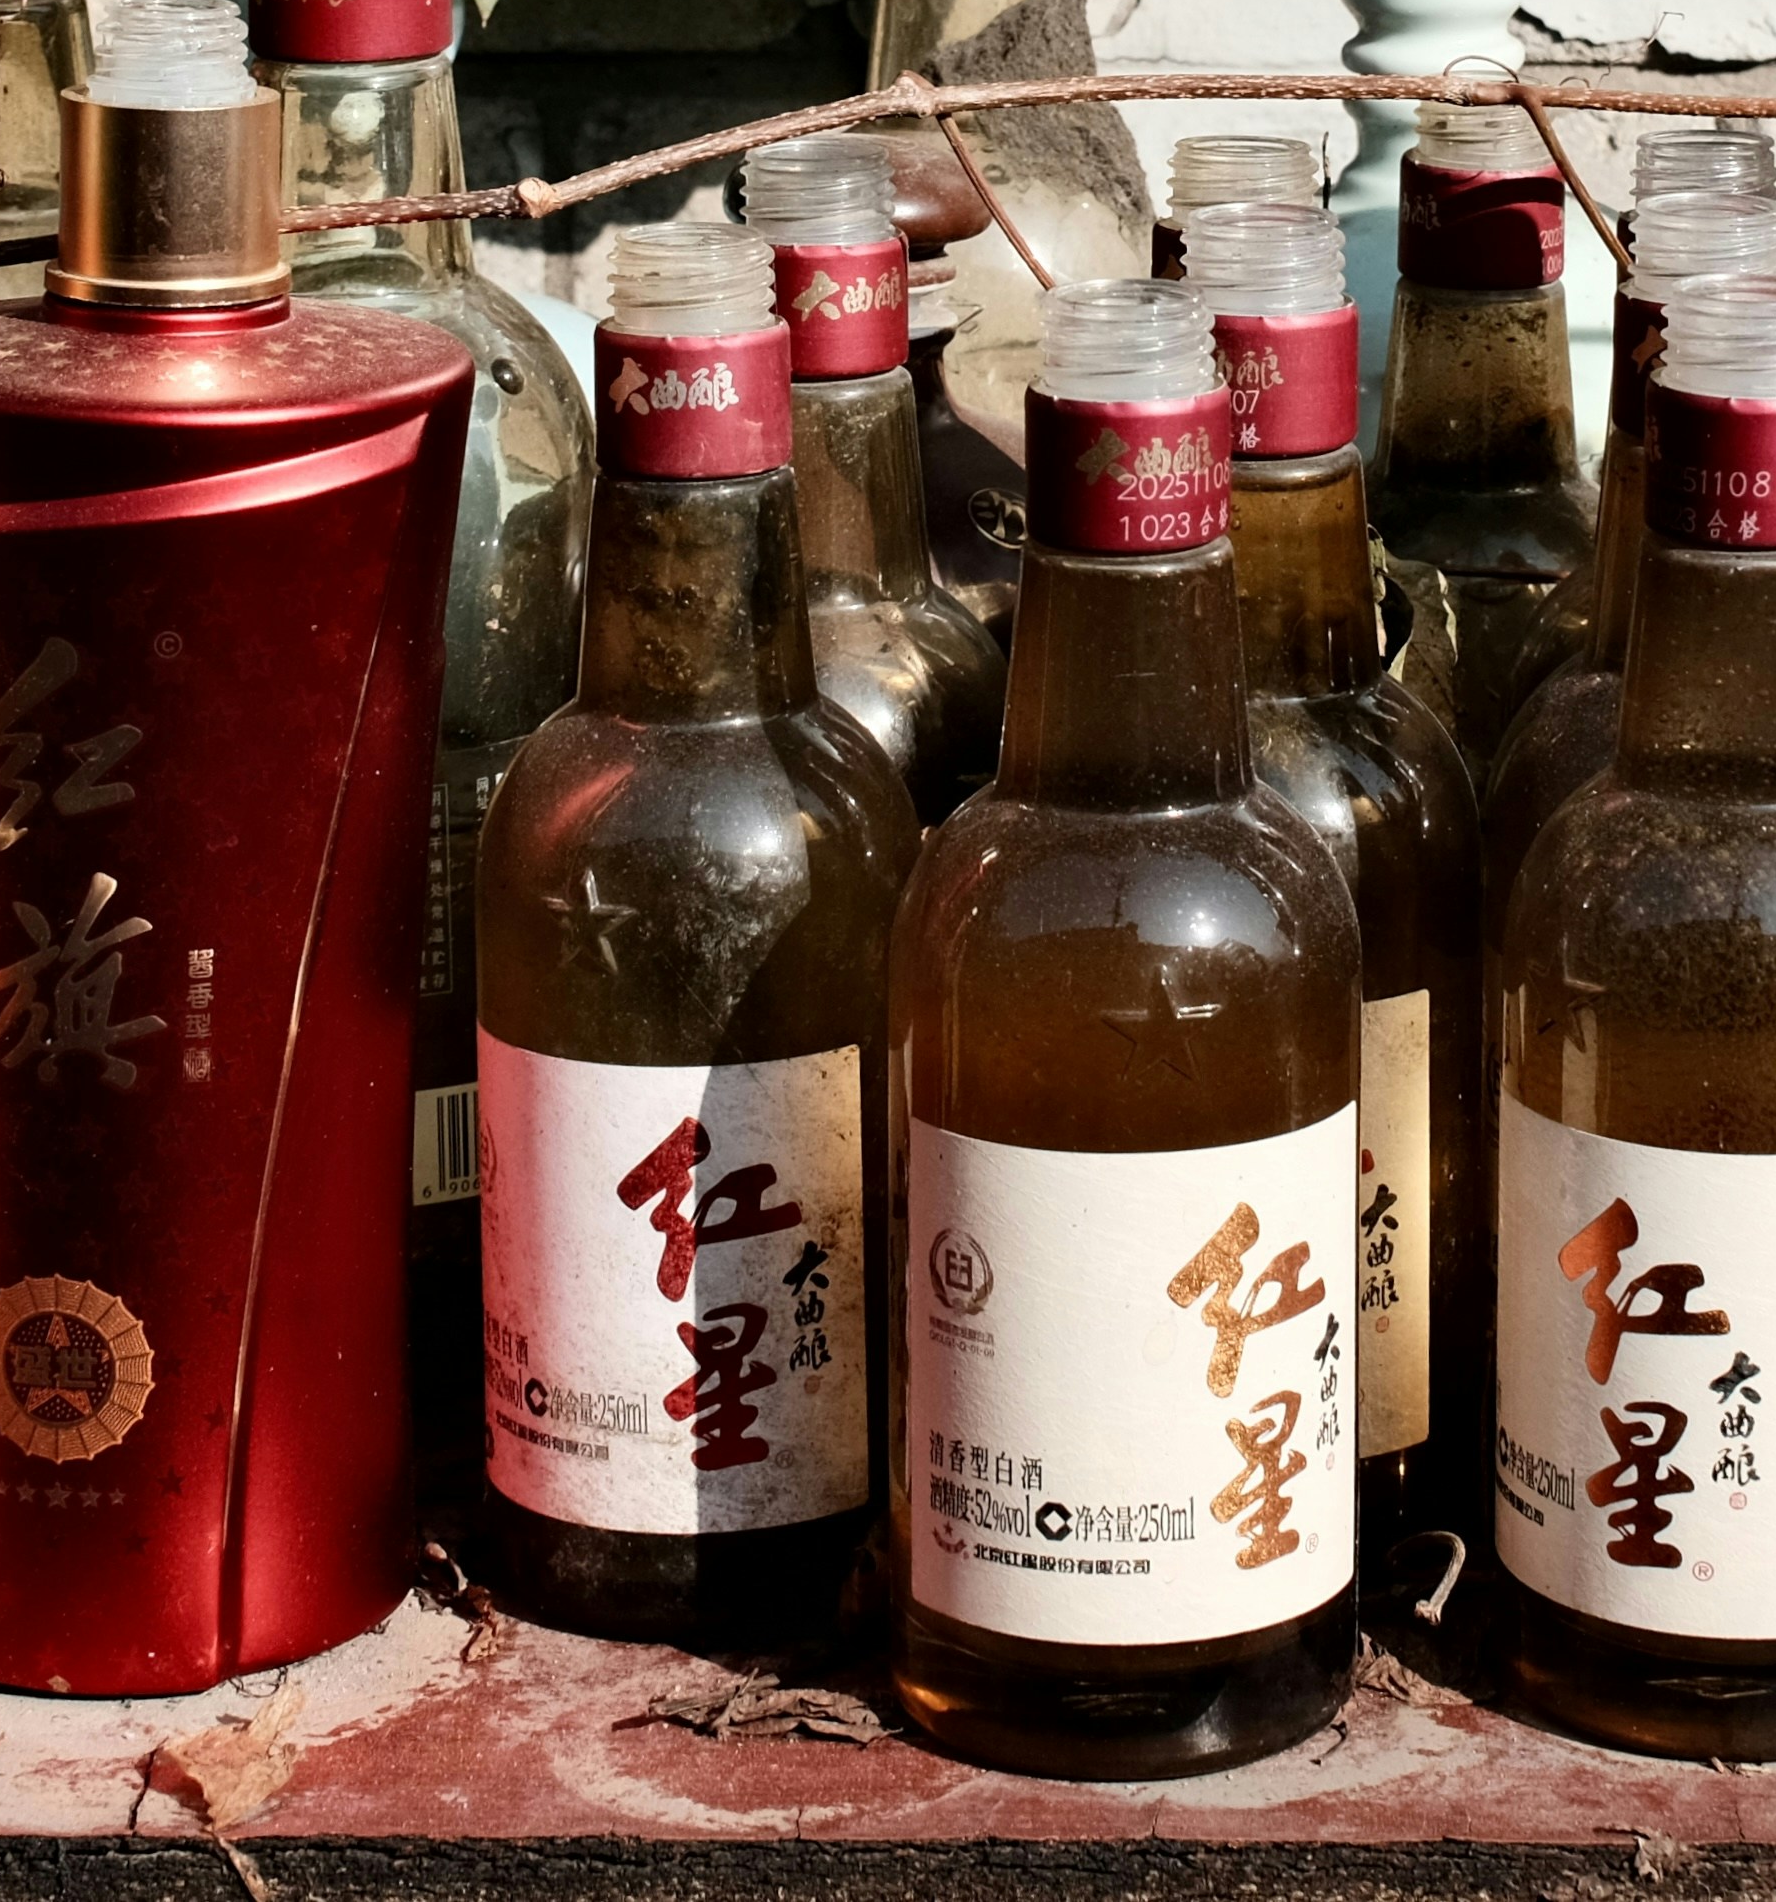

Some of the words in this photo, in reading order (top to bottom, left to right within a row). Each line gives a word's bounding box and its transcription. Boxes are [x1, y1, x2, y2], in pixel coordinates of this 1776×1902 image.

[791, 266, 904, 322] 大曲酿
[609, 357, 740, 415] 大曲酿
[1075, 426, 1215, 486] 大曲酿
[1140, 512, 1191, 541] 023
[1707, 509, 1760, 541] 合格
[1361, 1184, 1400, 1313] 大曲酿
[617, 1116, 802, 1472] 红星
[782, 1240, 831, 1373] 大曲酿
[549, 1384, 649, 1435] 净含量:250ml
[1167, 1202, 1326, 1570] 红星
[1314, 1313, 1342, 1451] 大曲酿
[1558, 1198, 1731, 1569] 红星
[1709, 1351, 1762, 1486] 大曲酿
[929, 1429, 1043, 1491] 清香型白酒
[1509, 1439, 1575, 1511] 净含量:250ml
[929, 1472, 1032, 1539] 酒精度:52%vol
[1075, 1496, 1196, 1543] 净含量:250ml
